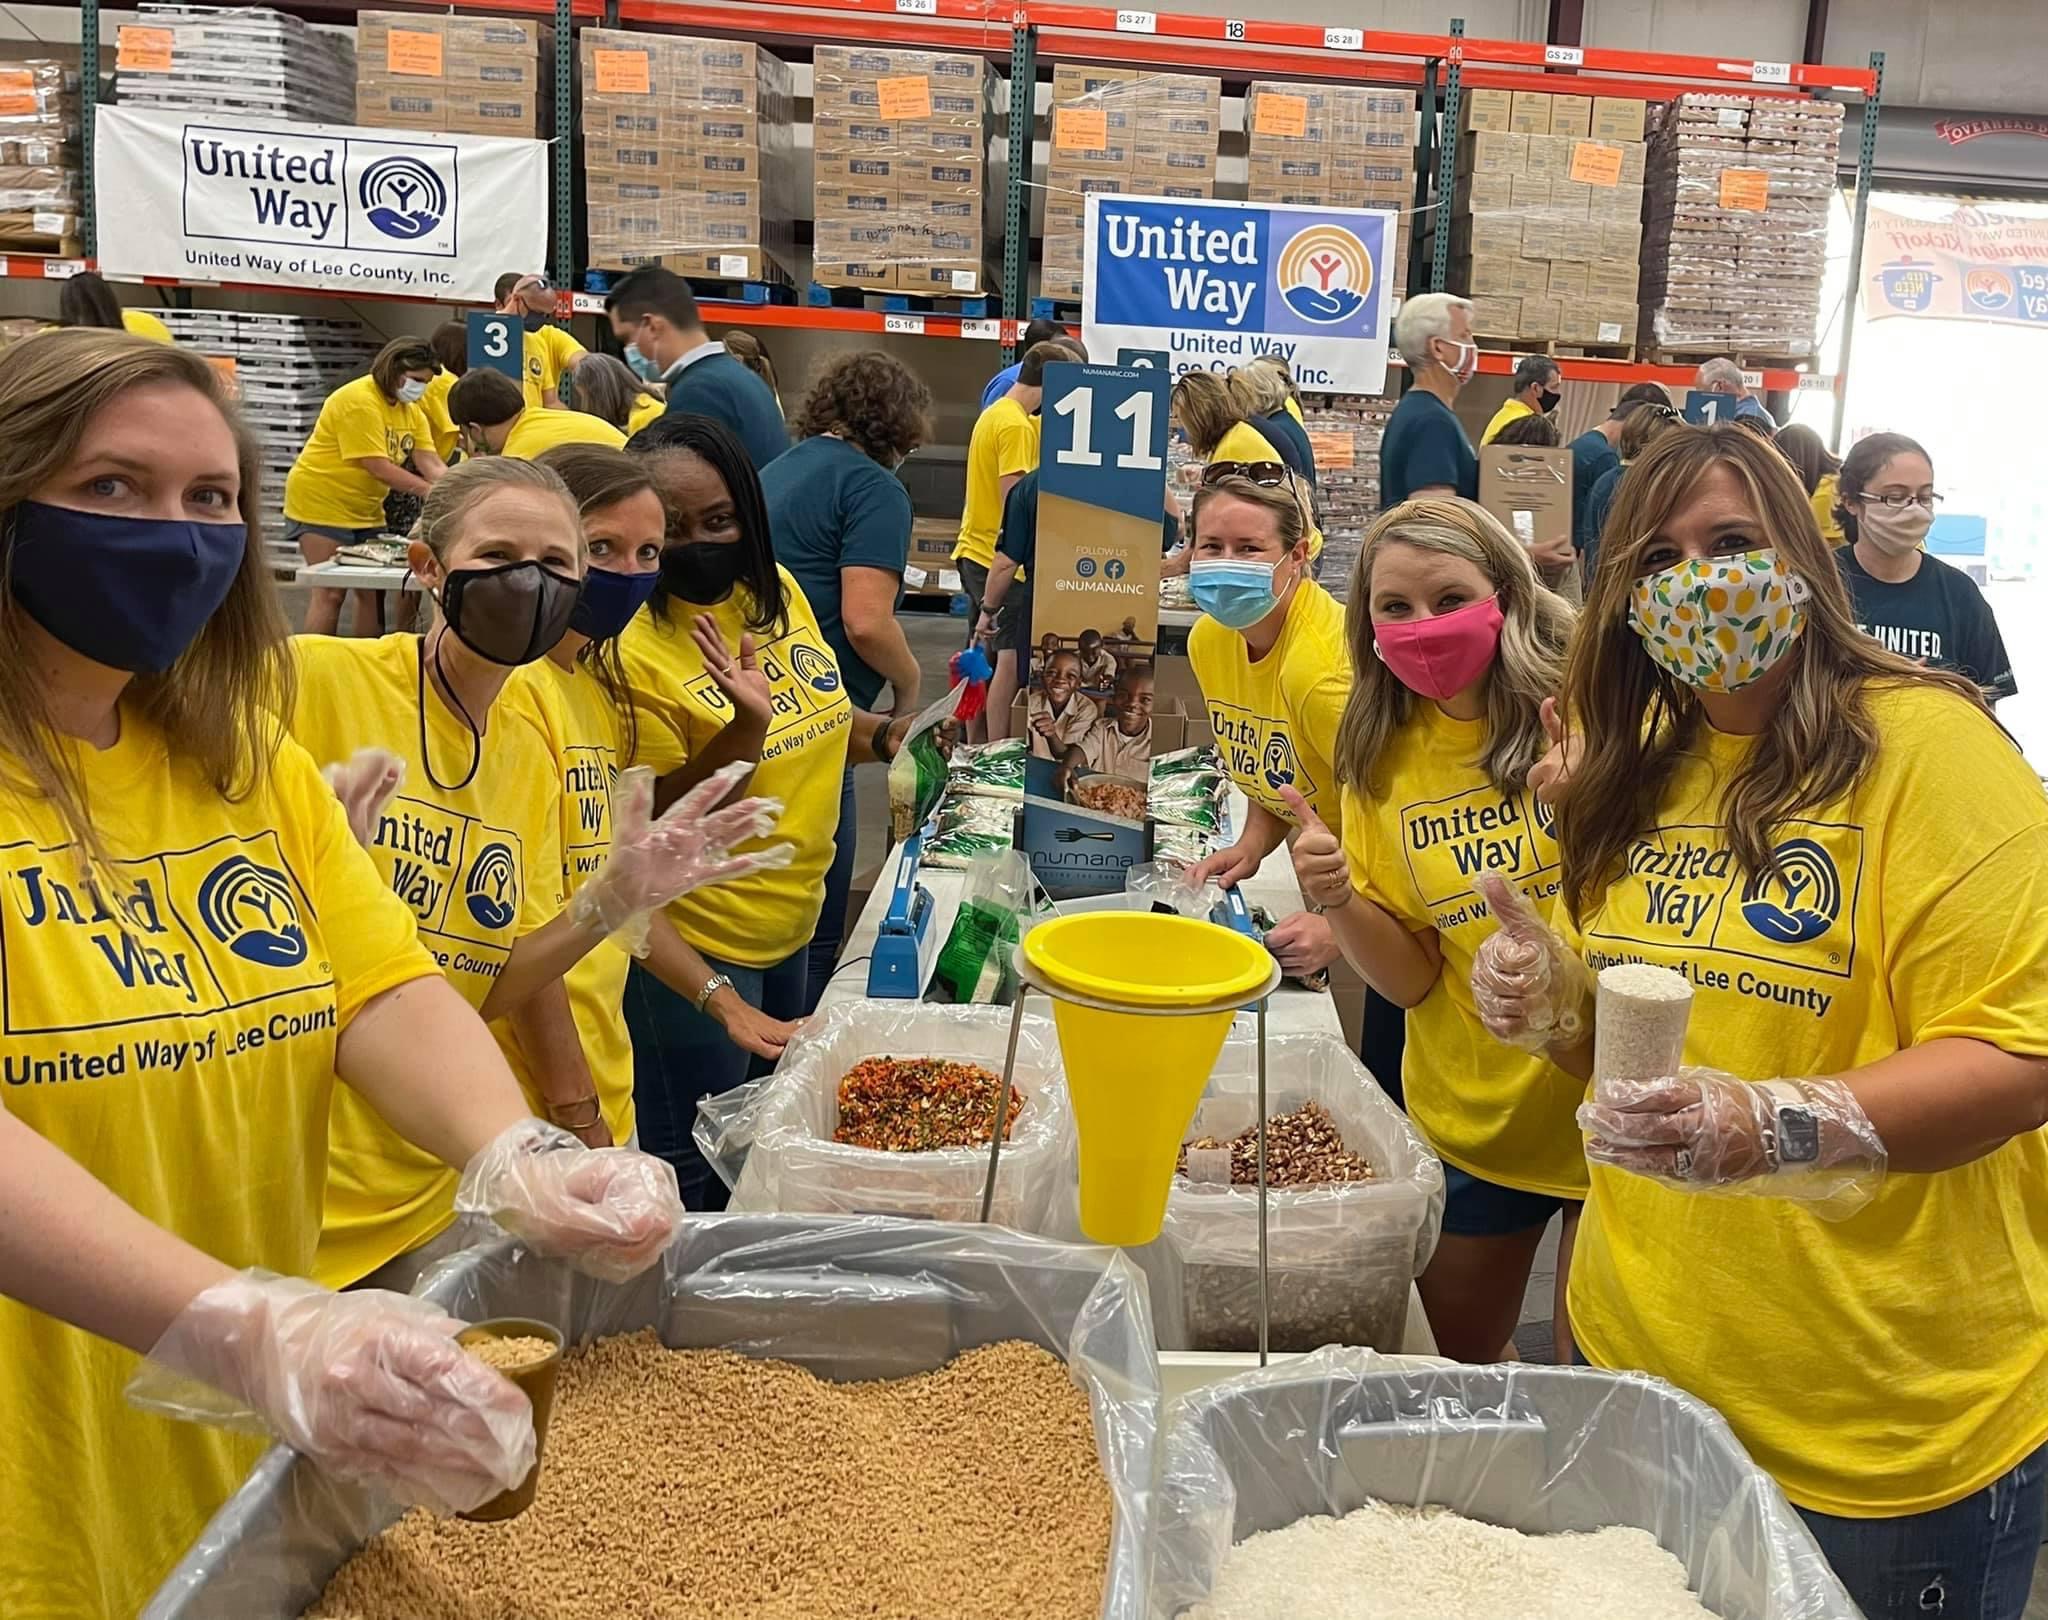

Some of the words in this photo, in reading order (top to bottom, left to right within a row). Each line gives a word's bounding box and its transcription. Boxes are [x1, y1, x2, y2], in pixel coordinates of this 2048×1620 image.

[1119, 14, 1132, 23] GS
[1135, 15, 1146, 24] 27
[1226, 23, 1244, 38] 18
[1326, 35, 1340, 43] GS
[1342, 36, 1353, 45] 28
[1547, 51, 1561, 60] GS
[1562, 52, 1573, 61] 29
[1754, 66, 1768, 74] GS
[1770, 67, 1781, 76] 30
[1952, 120, 2033, 139] OVERHEAD
[191, 139, 336, 185] United
[250, 186, 337, 241] Way
[1105, 214, 1258, 265] United
[186, 250, 240, 267] United
[246, 255, 283, 274] Way
[289, 259, 306, 272] of
[313, 260, 343, 275] Lee
[350, 263, 418, 285] County,
[423, 268, 455, 285] Inc.
[575, 299, 589, 307] GS
[597, 300, 603, 308] 5
[1164, 266, 1257, 326] Way
[483, 322, 509, 357] 3
[887, 321, 901, 329] GS
[904, 321, 914, 330] 16
[963, 322, 977, 331] GS
[984, 323, 990, 332] 6
[1170, 332, 1242, 354] United
[1250, 337, 1297, 361] Way
[1082, 369, 1139, 378] NUMANAINC.COM
[1296, 364, 1334, 385] Inc.
[1800, 379, 1811, 387] GS
[1700, 400, 1718, 425] 1
[1053, 386, 1162, 471] 11
[1076, 545, 1114, 556] FOLLOW
[1116, 548, 1128, 557] US
[1056, 579, 1144, 595] @NUMANAINC
[771, 687, 802, 715] ay
[782, 735, 805, 751] Way
[806, 725, 817, 740] of
[817, 720, 835, 734] Lee
[1409, 799, 1520, 849] United
[373, 812, 453, 866] nited
[1033, 851, 1134, 867] numana
[1451, 835, 1523, 875] Way
[393, 857, 443, 919] Way
[1645, 880, 1715, 938] Way
[91, 930, 198, 1003] Way
[454, 953, 501, 977] Count
[1693, 962, 1729, 989] Lee
[1737, 973, 1832, 1017] County
[5, 1045, 125, 1085] United
[135, 1039, 190, 1071] Way
[269, 1004, 337, 1041] Count
